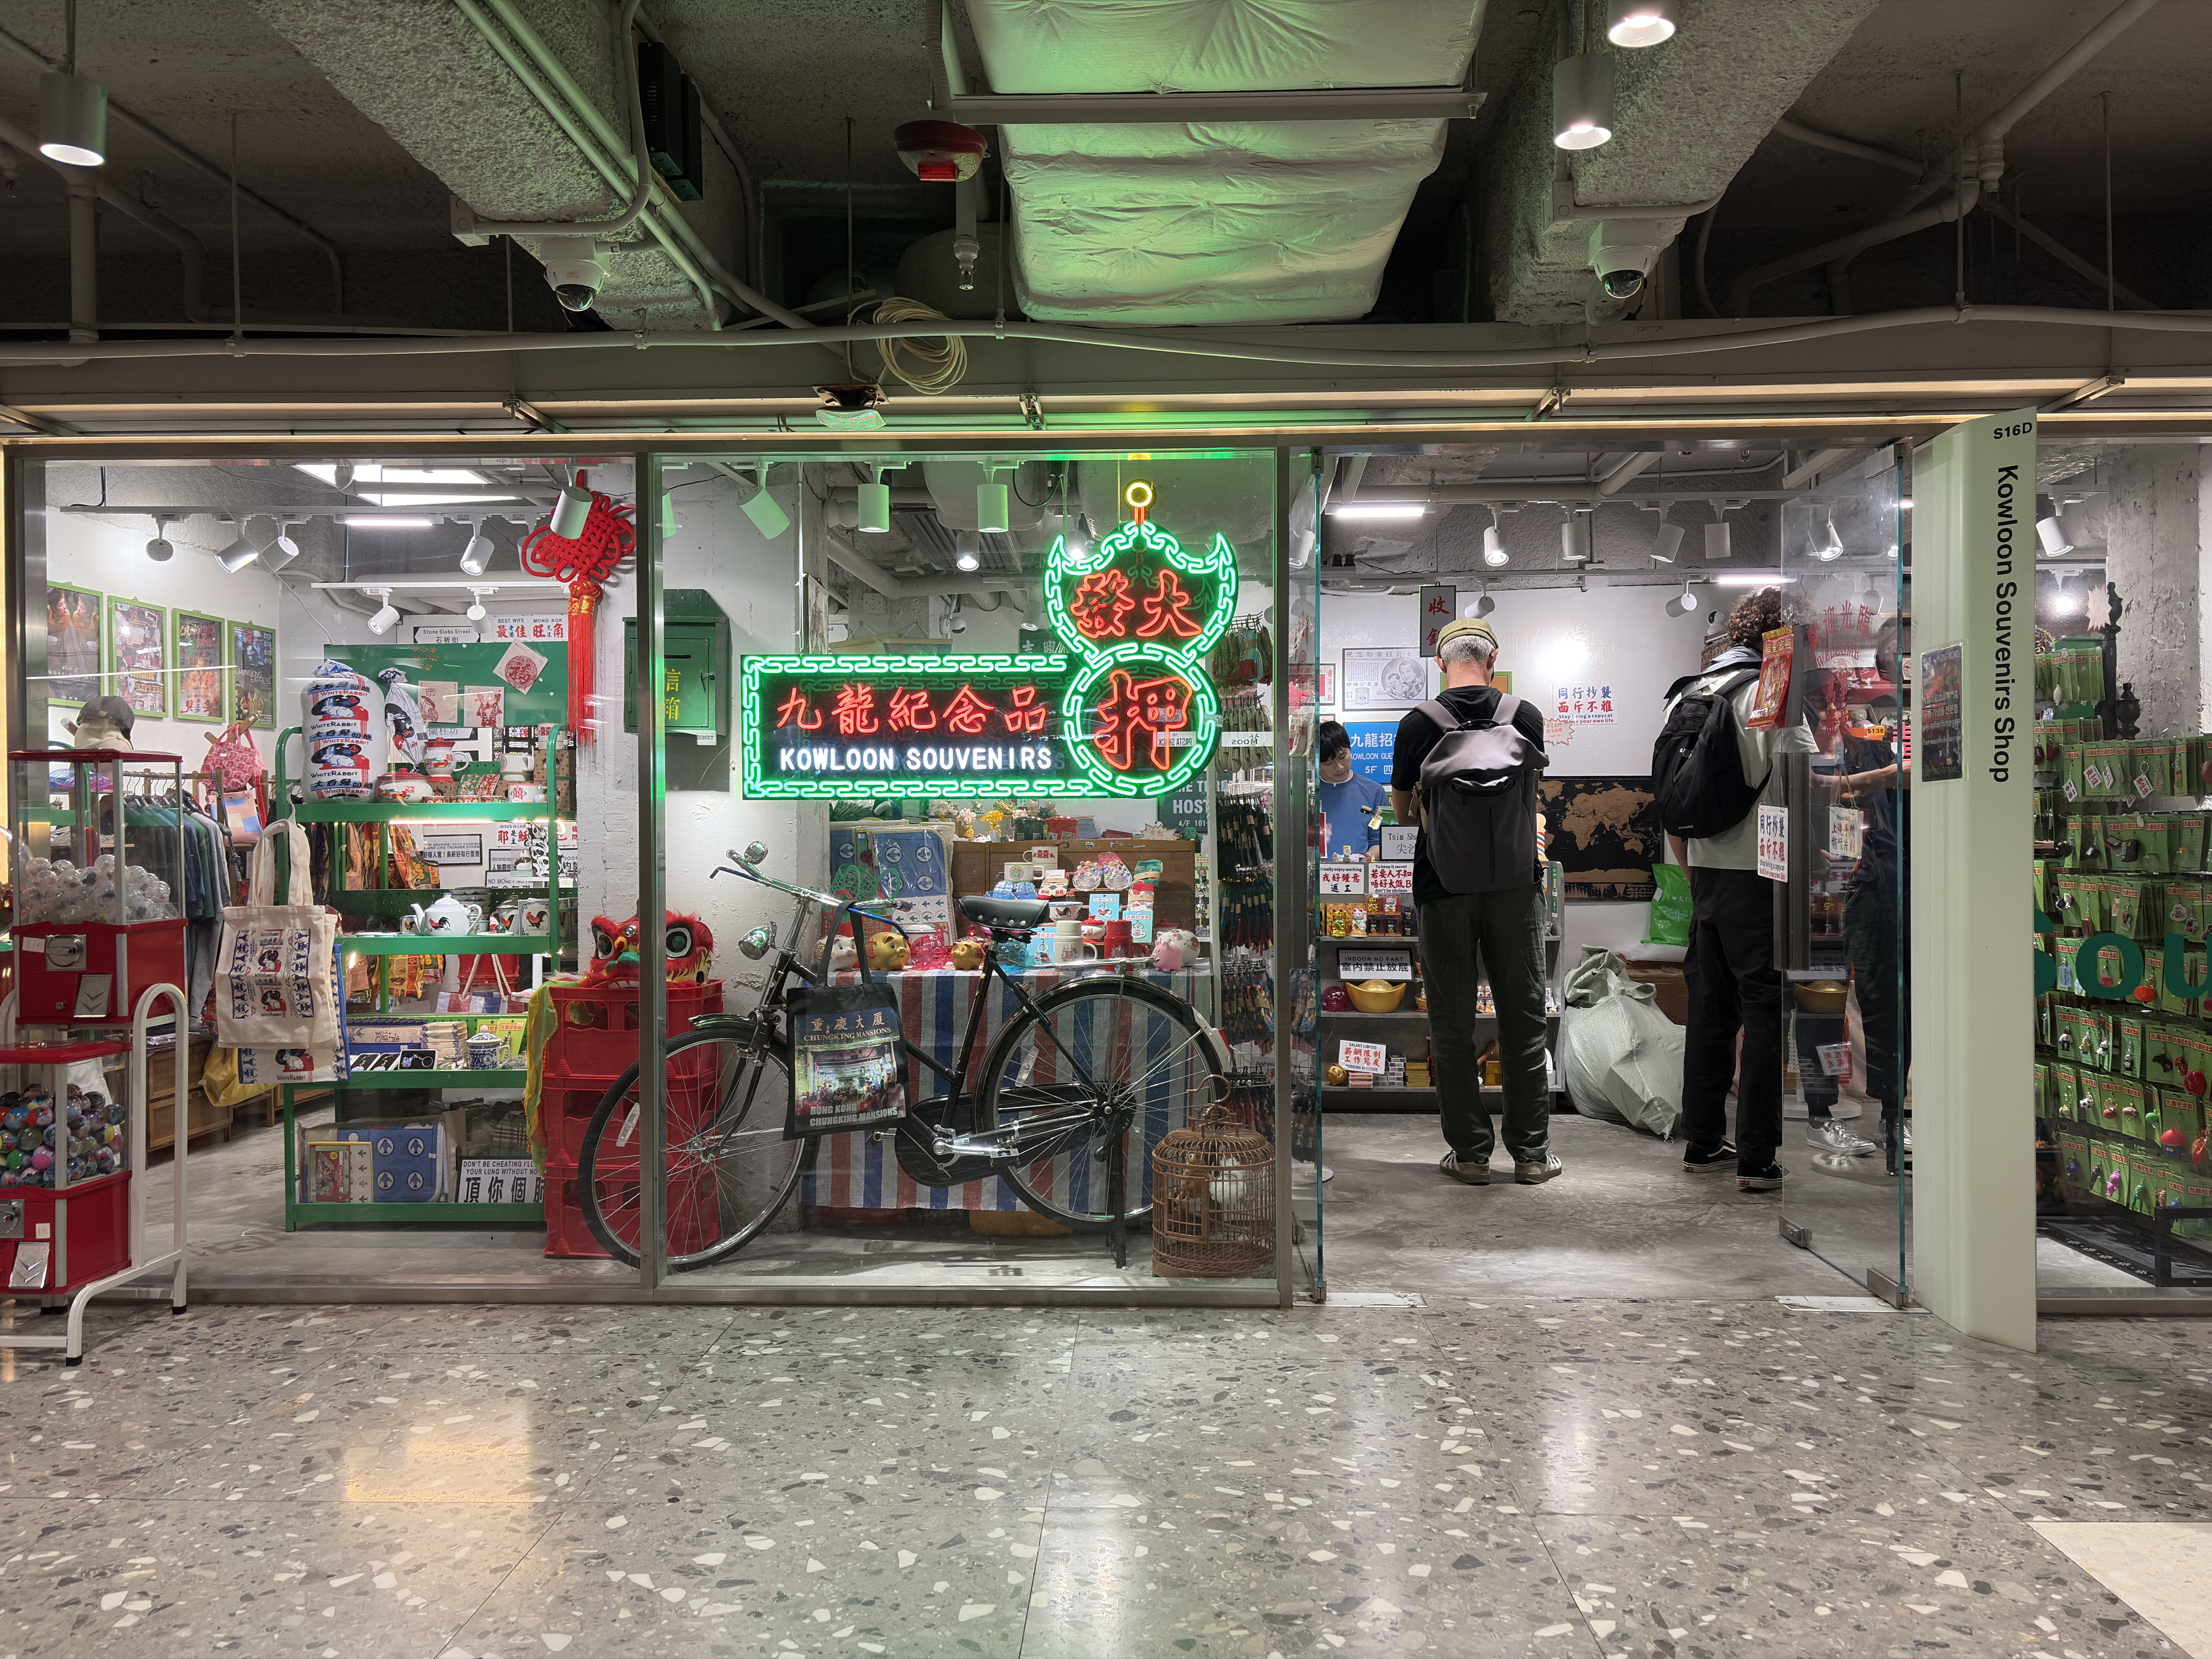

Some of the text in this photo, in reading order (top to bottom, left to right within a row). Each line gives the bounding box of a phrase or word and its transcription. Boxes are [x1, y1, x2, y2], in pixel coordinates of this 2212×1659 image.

[1994, 422, 2032, 439] S16D
[1989, 465, 2018, 783] Kowloon Souvenirs Shop
[1765, 638, 1791, 655] 福星高照
[1558, 686, 1612, 700] 同行抄襲
[777, 684, 1046, 735] 九龍紀念品
[1558, 700, 1613, 713] 面斥不雅
[1094, 670, 1193, 770] 押
[1350, 733, 1397, 748] 九龍招
[781, 748, 1052, 771] KOWLOON SOUVENIRS
[1760, 815, 1785, 838] 同行抄襲
[1760, 838, 1785, 862] 面斥不雅
[1370, 869, 1412, 879] 若要人不知
[1331, 883, 1352, 893] 返工
[804, 1027, 891, 1041] CHUNGKING MANSIONS
[1344, 1047, 1381, 1059] 薪酬限制
[1344, 1056, 1380, 1067] 工作態度
[810, 1103, 857, 1115] HONG KONG
[810, 1107, 898, 1127] CHUNGKING MANSIONS
